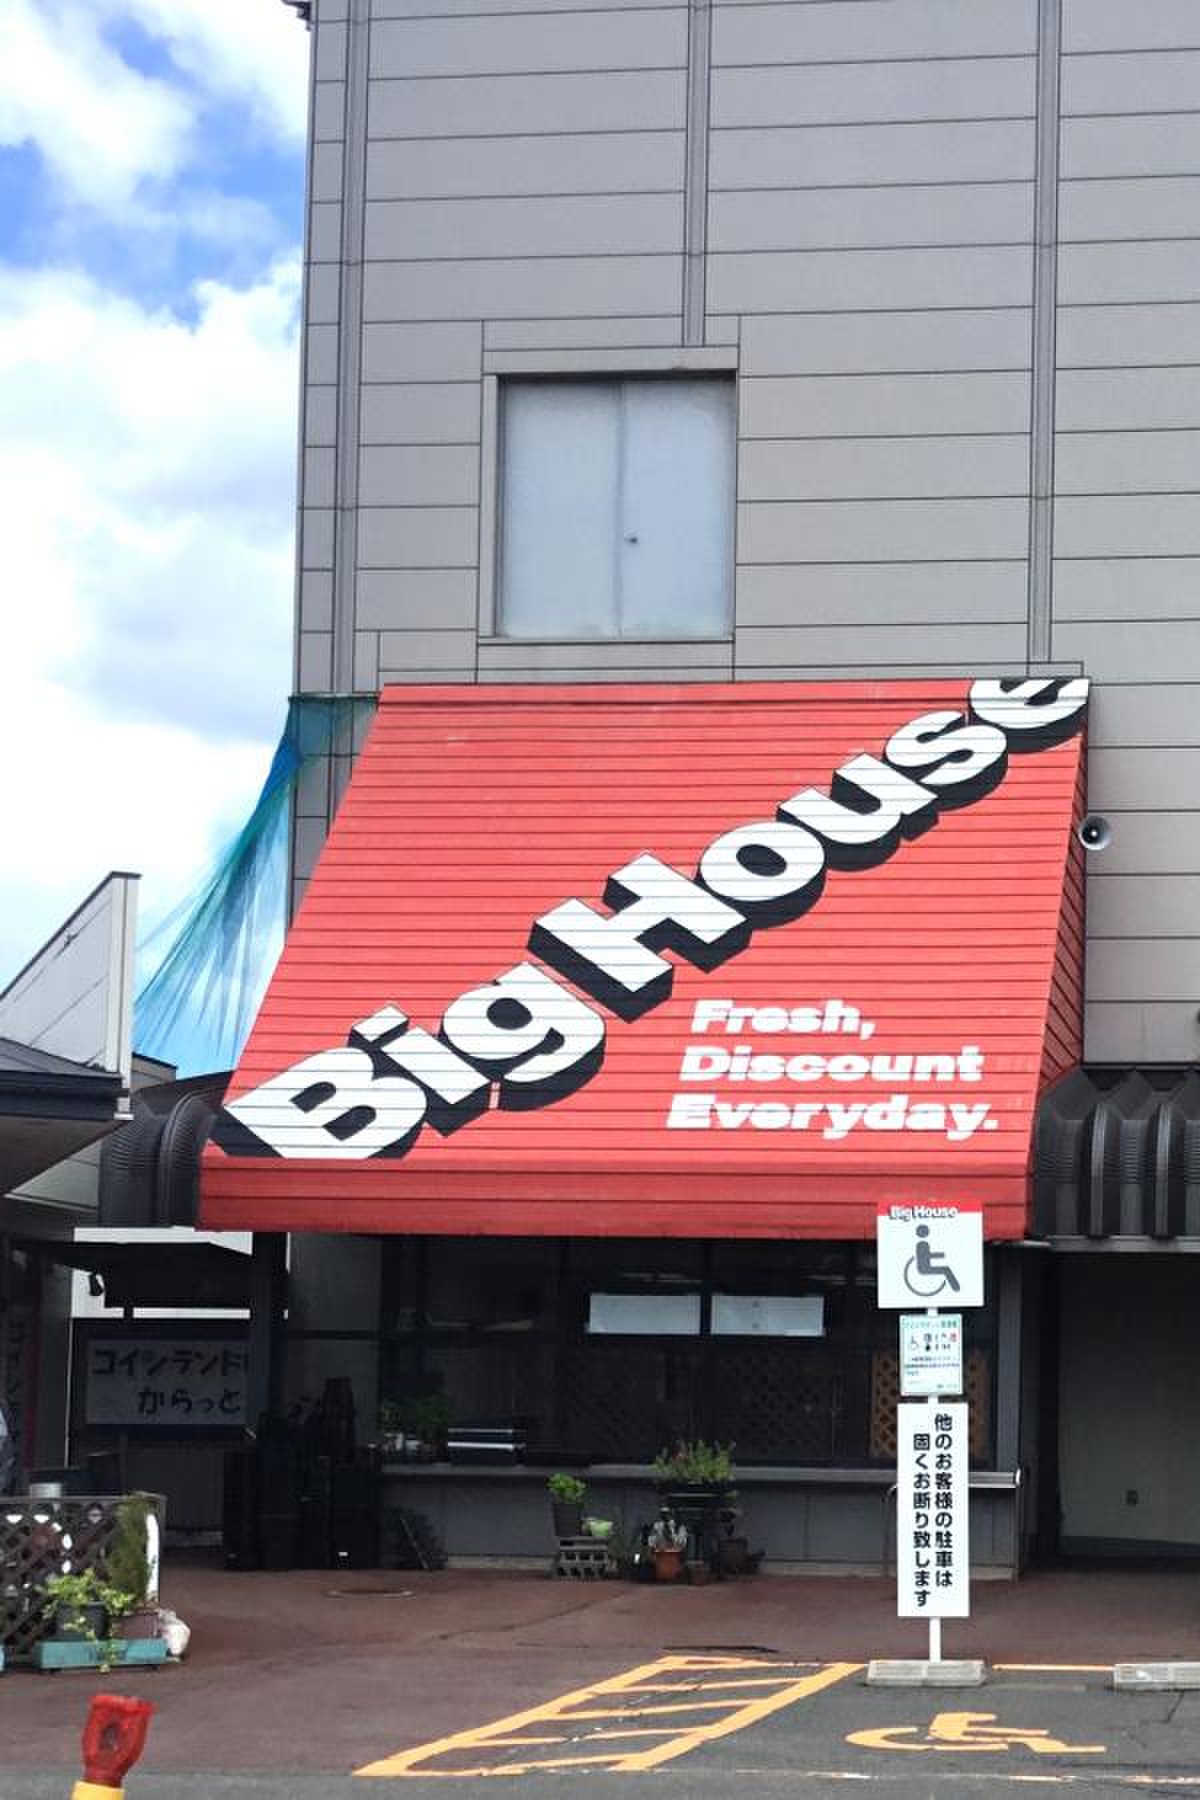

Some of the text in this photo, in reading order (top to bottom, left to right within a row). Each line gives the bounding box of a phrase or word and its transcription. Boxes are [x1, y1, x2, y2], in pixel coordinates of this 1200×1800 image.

[216, 679, 1090, 1159] Big House
[691, 999, 875, 1040] Fresh,
[679, 1045, 985, 1082] Discount
[666, 1094, 998, 1140] Everyday.
[889, 1204, 959, 1222] Big House
[138, 1387, 241, 1414] からっと
[913, 1433, 931, 1607] 固くお断り致します
[934, 1413, 953, 1588] 他のお客様の駐車は
